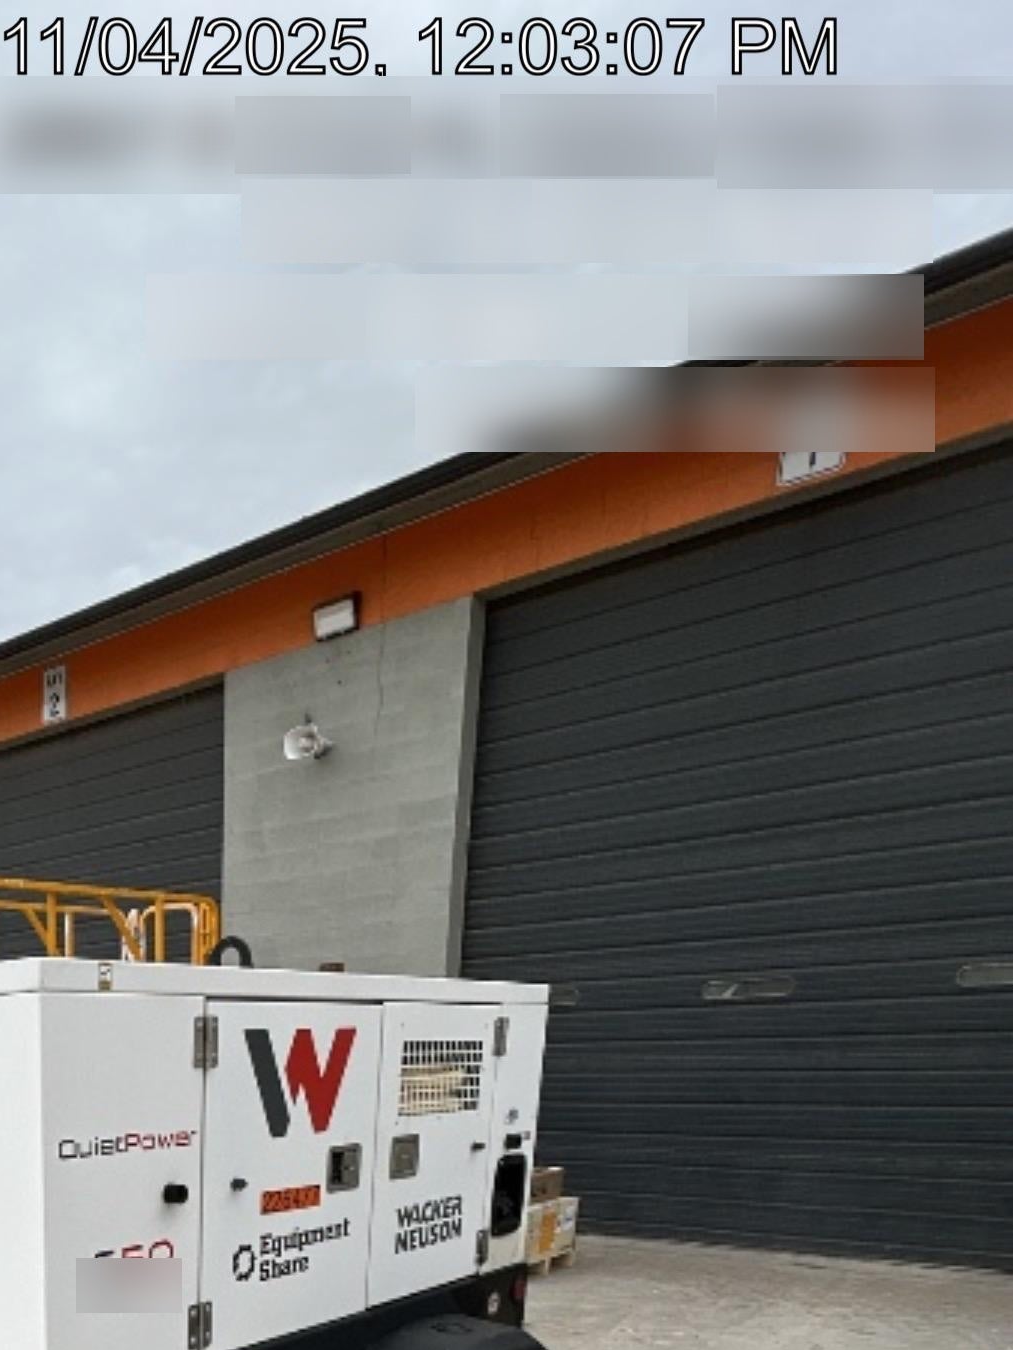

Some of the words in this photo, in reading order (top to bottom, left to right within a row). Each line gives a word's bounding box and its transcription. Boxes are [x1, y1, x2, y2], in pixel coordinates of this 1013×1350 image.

[58, 1129, 197, 1160] QuietPower
[395, 1194, 463, 1228] WACKER
[259, 1217, 350, 1257] Equipment
[394, 1217, 462, 1255] NEUSON
[259, 1256, 309, 1281] Share
